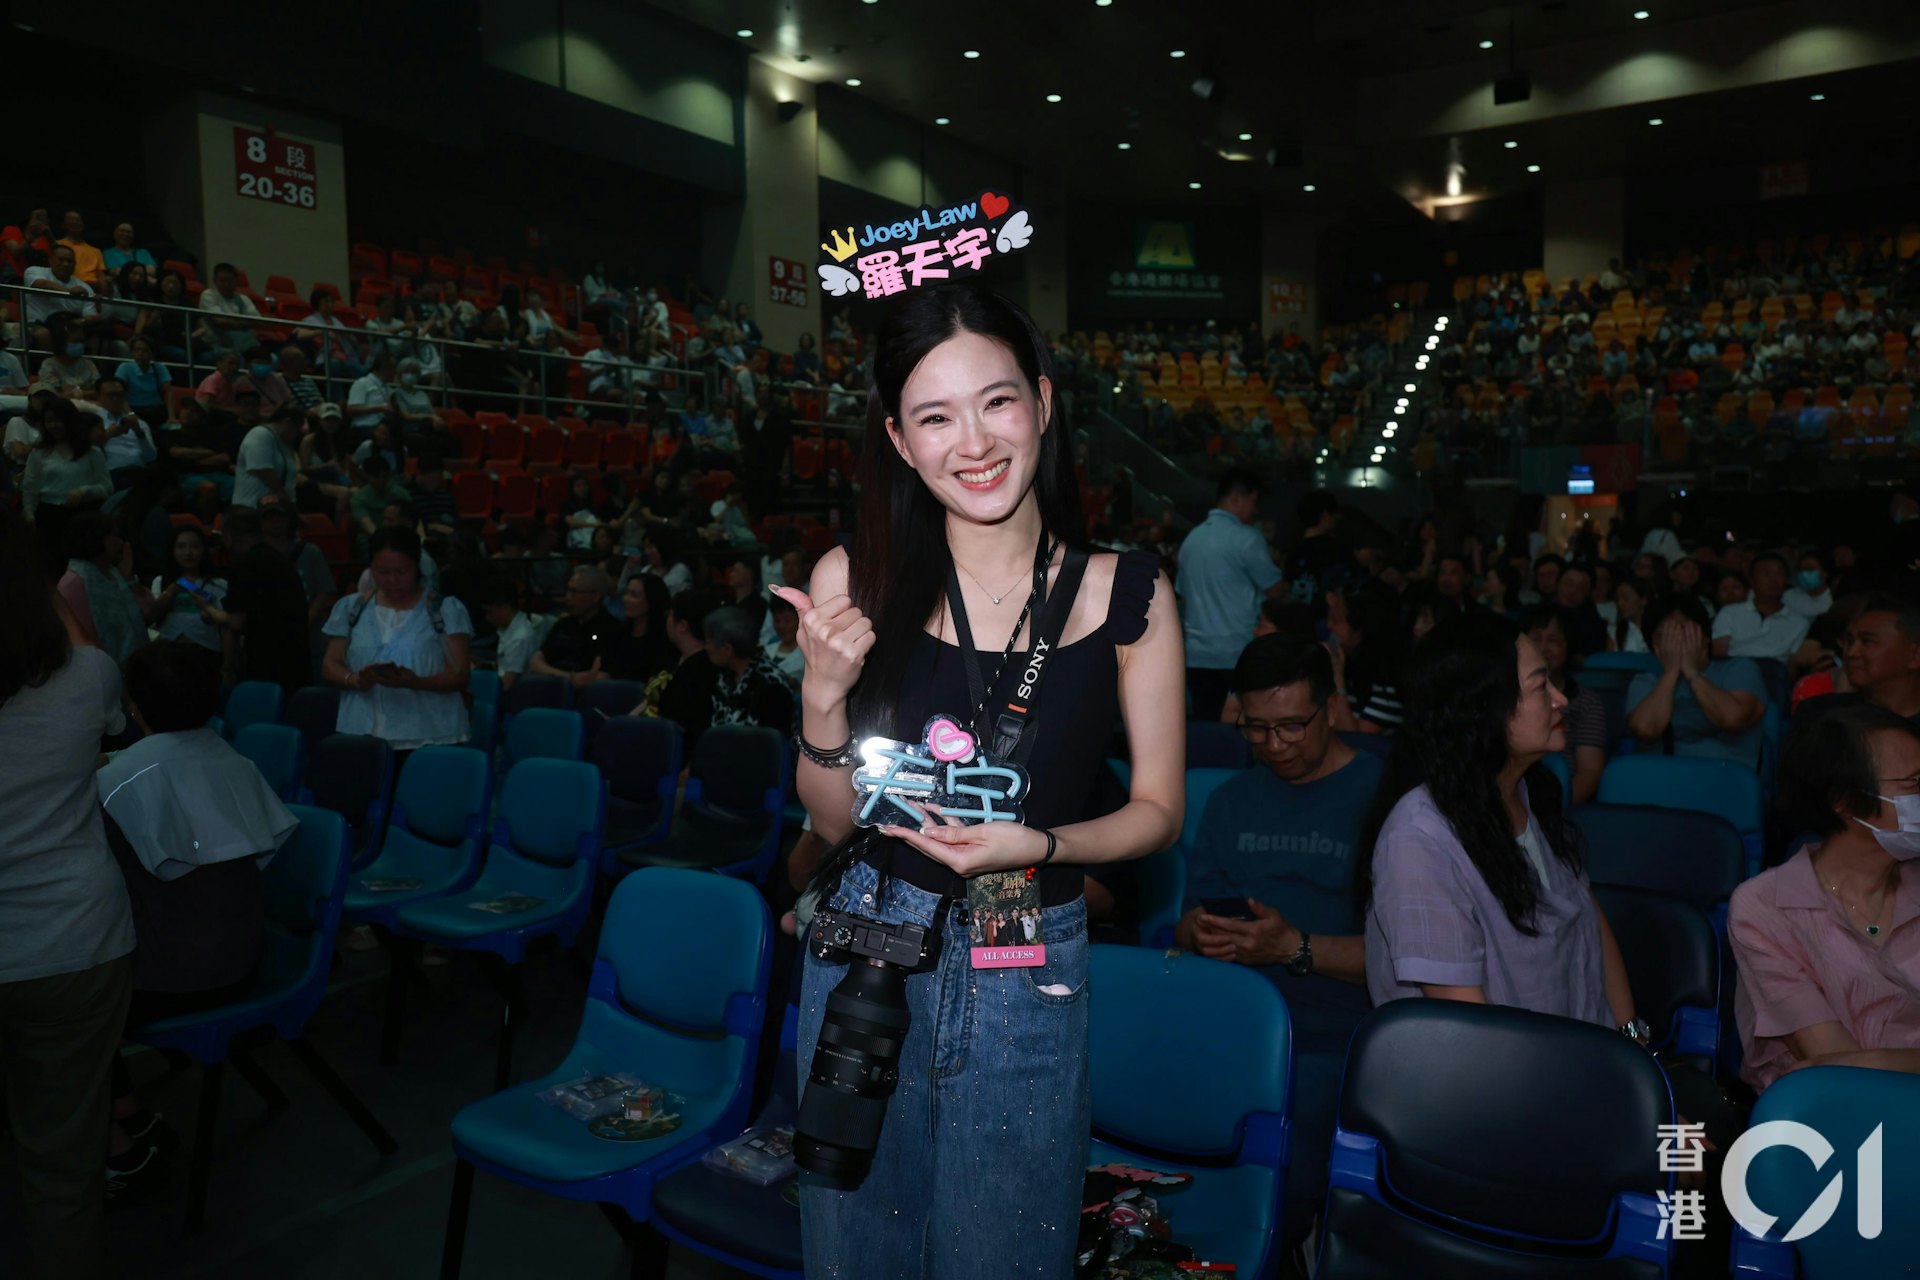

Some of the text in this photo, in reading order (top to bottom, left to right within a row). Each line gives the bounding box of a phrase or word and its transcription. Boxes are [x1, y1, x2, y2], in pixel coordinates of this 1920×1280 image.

[247, 136, 267, 163] 8
[287, 146, 306, 169] 段
[274, 166, 315, 181] SECTION
[239, 172, 315, 208] 20-36
[773, 260, 785, 279] 9
[1017, 636, 1050, 700] SONY
[1237, 831, 1350, 859] Reunion
[981, 950, 1035, 961] ALL ACCESS
